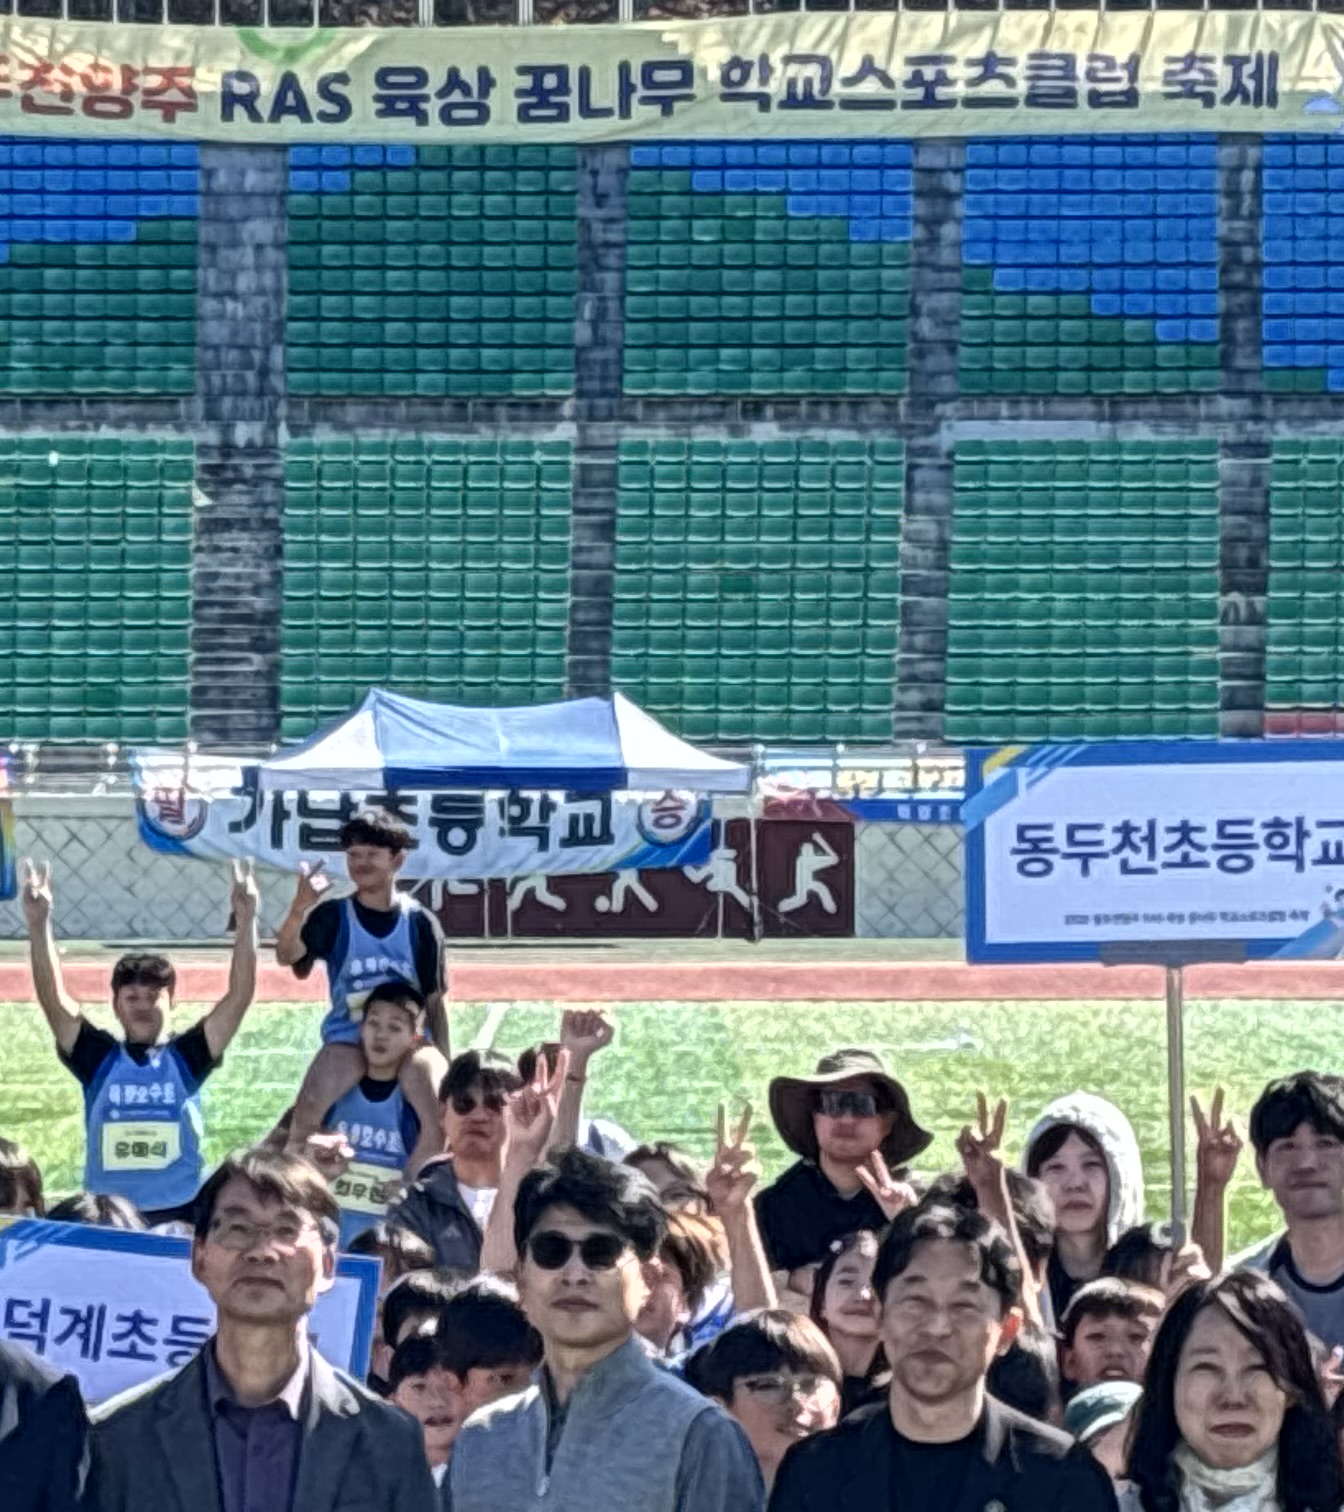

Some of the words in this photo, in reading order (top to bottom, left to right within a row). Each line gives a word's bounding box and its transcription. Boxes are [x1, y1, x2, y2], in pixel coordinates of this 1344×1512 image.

[220, 71, 351, 127] RAS
[372, 64, 495, 128] 육상
[513, 57, 697, 124] 꿈나무
[1161, 50, 1279, 110] 축제
[2, 1297, 216, 1369] 덕계초등
